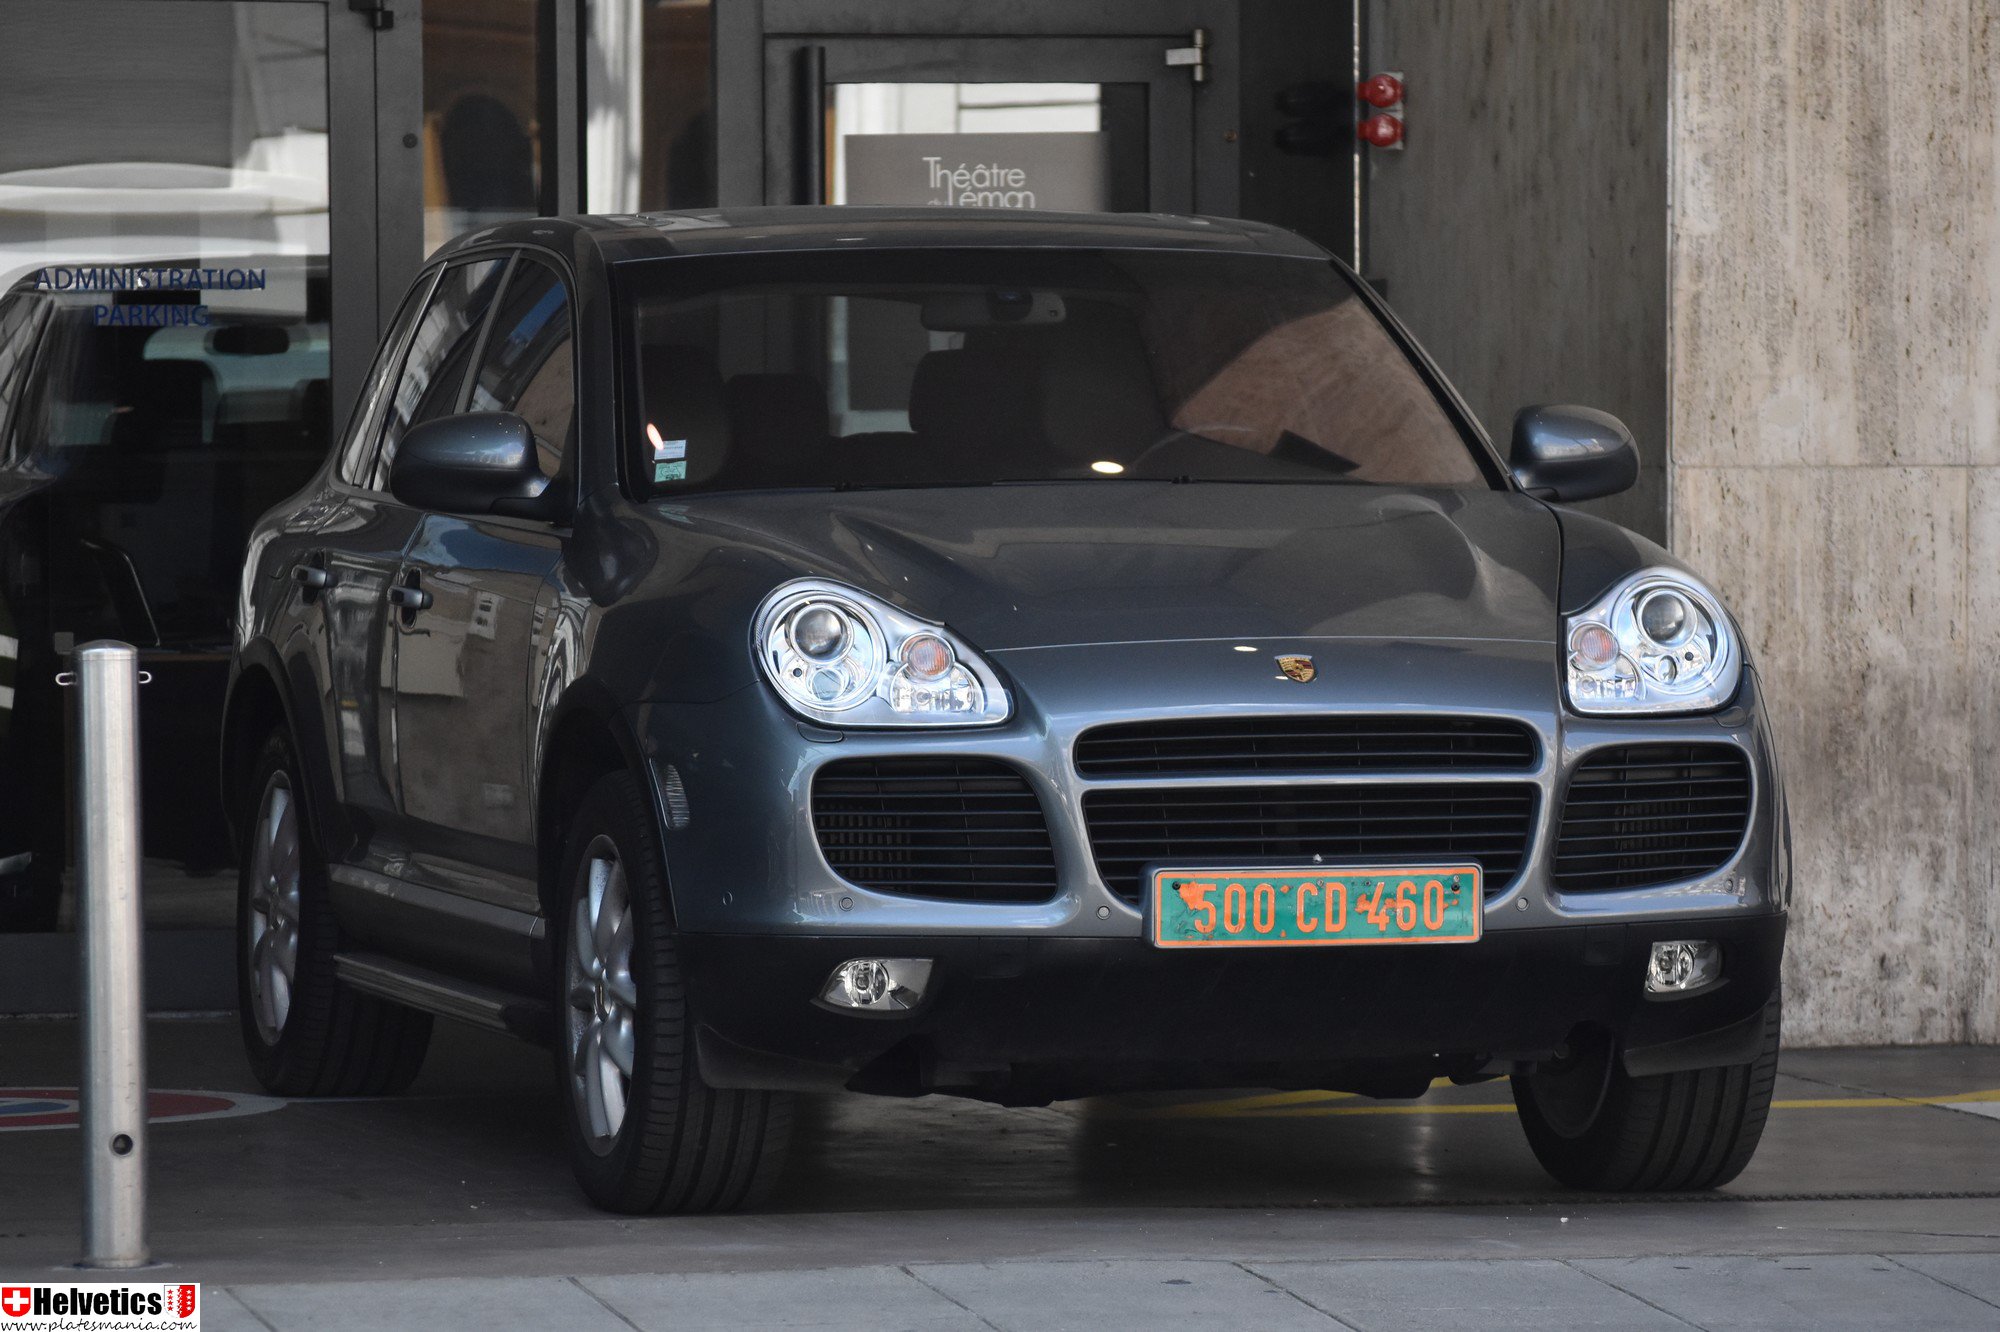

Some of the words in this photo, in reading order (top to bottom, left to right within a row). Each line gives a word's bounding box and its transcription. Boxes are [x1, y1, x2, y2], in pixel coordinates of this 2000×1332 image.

[922, 156, 1026, 189] Théâtre
[34, 267, 267, 291] ADMINISTRATION
[94, 304, 210, 327] PARKING
[1193, 882, 1275, 935] 500
[1296, 881, 1347, 934] CD
[1366, 880, 1445, 932] 460
